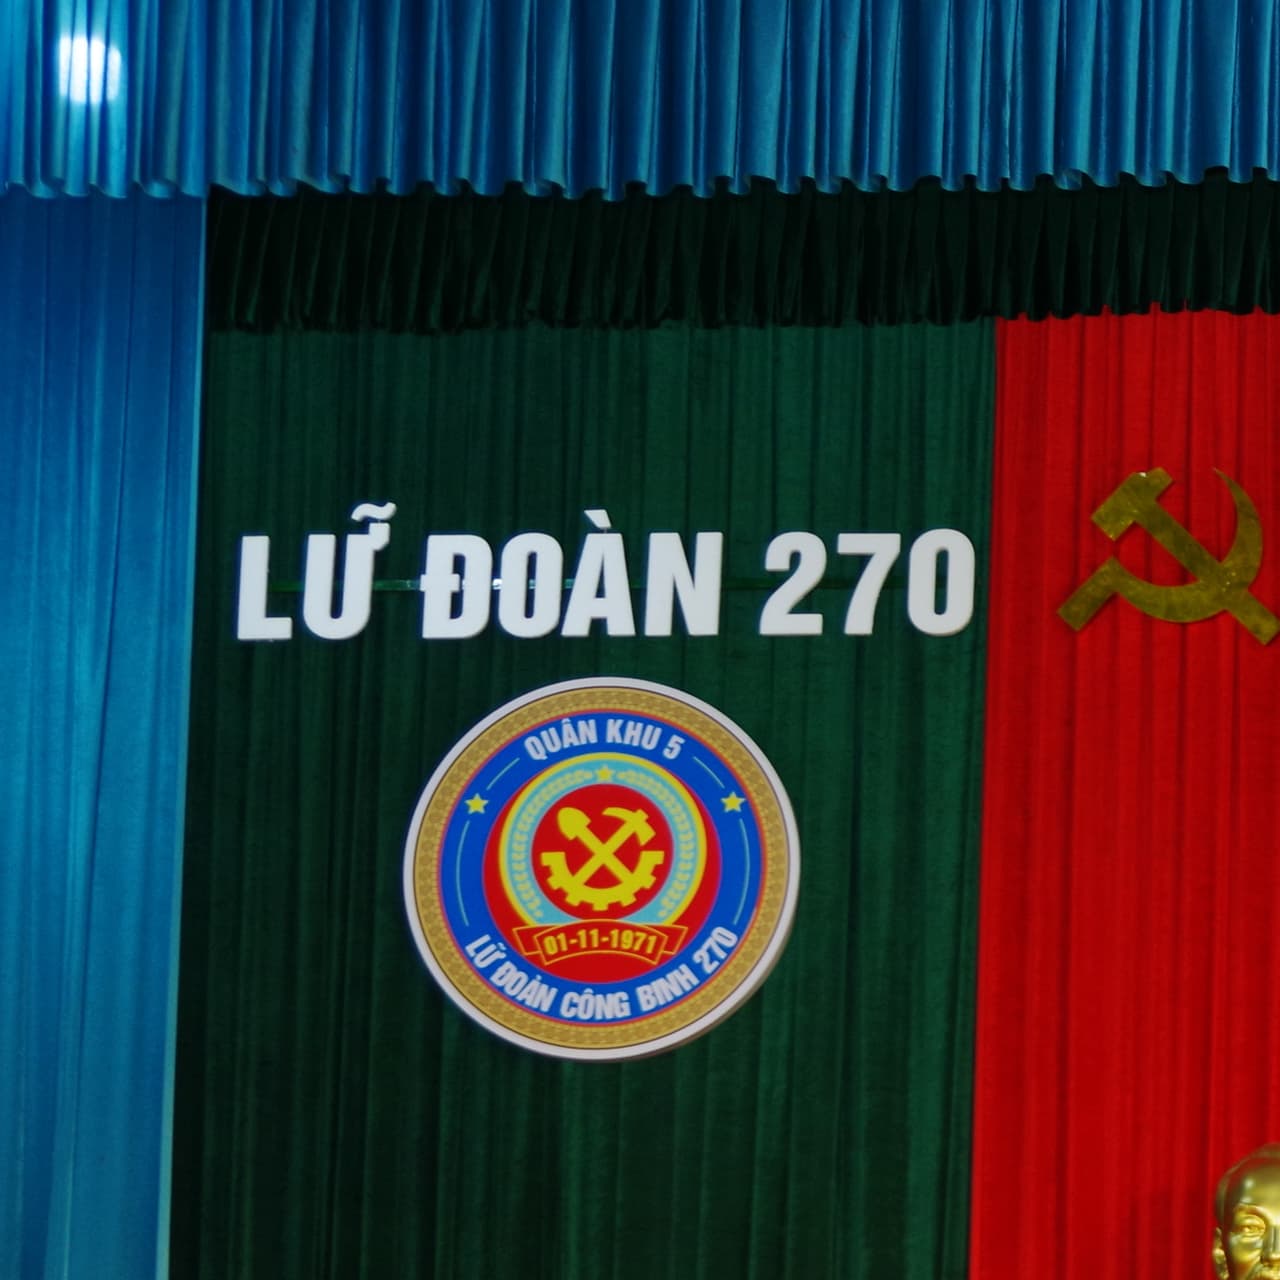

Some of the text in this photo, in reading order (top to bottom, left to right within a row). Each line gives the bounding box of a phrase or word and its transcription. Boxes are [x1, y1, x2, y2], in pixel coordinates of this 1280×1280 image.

[238, 503, 975, 640] LỮ ĐOÀN 270
[524, 718, 686, 760] QUÂN KHU 5
[465, 926, 739, 1020] LỮ ĐOÀN CÔNG BINH 270
[543, 928, 657, 955] 01-11-1971
